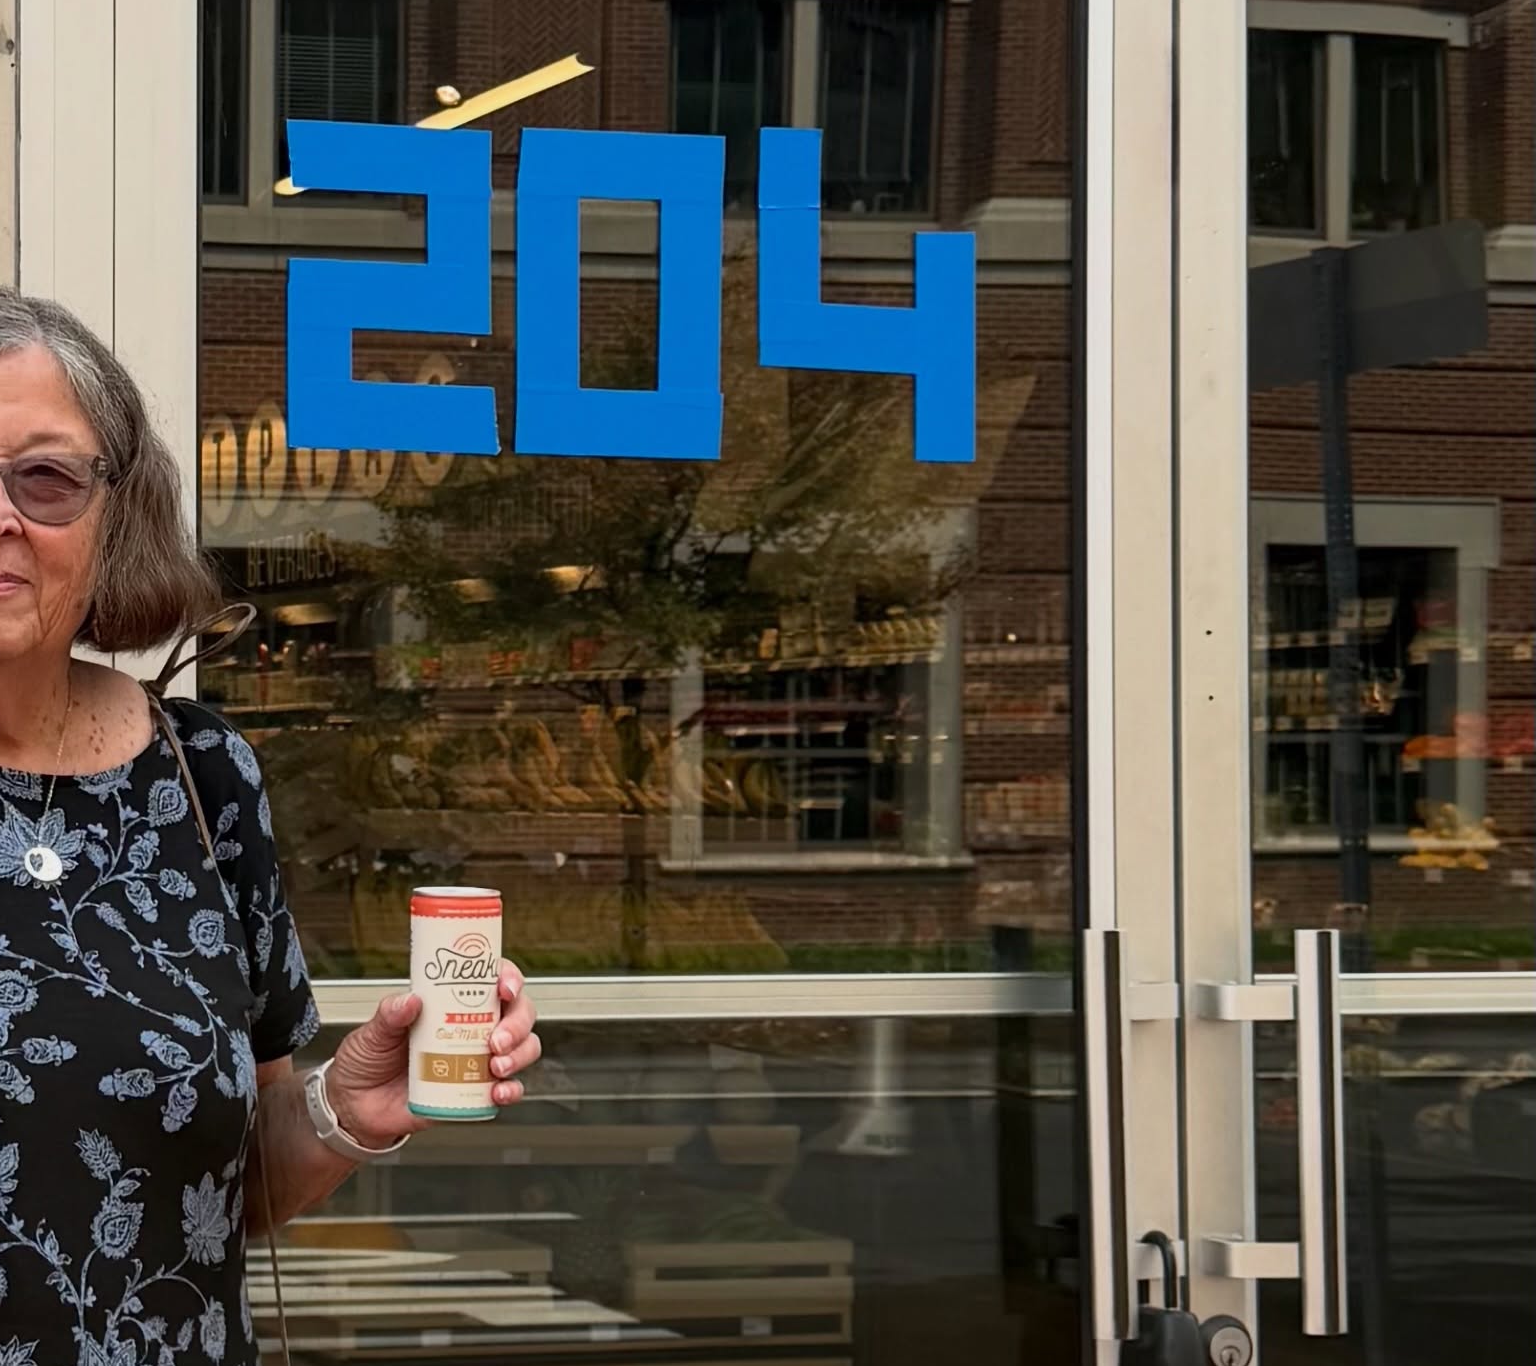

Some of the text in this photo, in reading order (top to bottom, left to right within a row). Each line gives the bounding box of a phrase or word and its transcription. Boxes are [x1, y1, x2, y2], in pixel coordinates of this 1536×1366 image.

[286, 119, 977, 463] 204
[247, 529, 336, 588] BEVERAGES
[424, 947, 499, 981] Sneak
